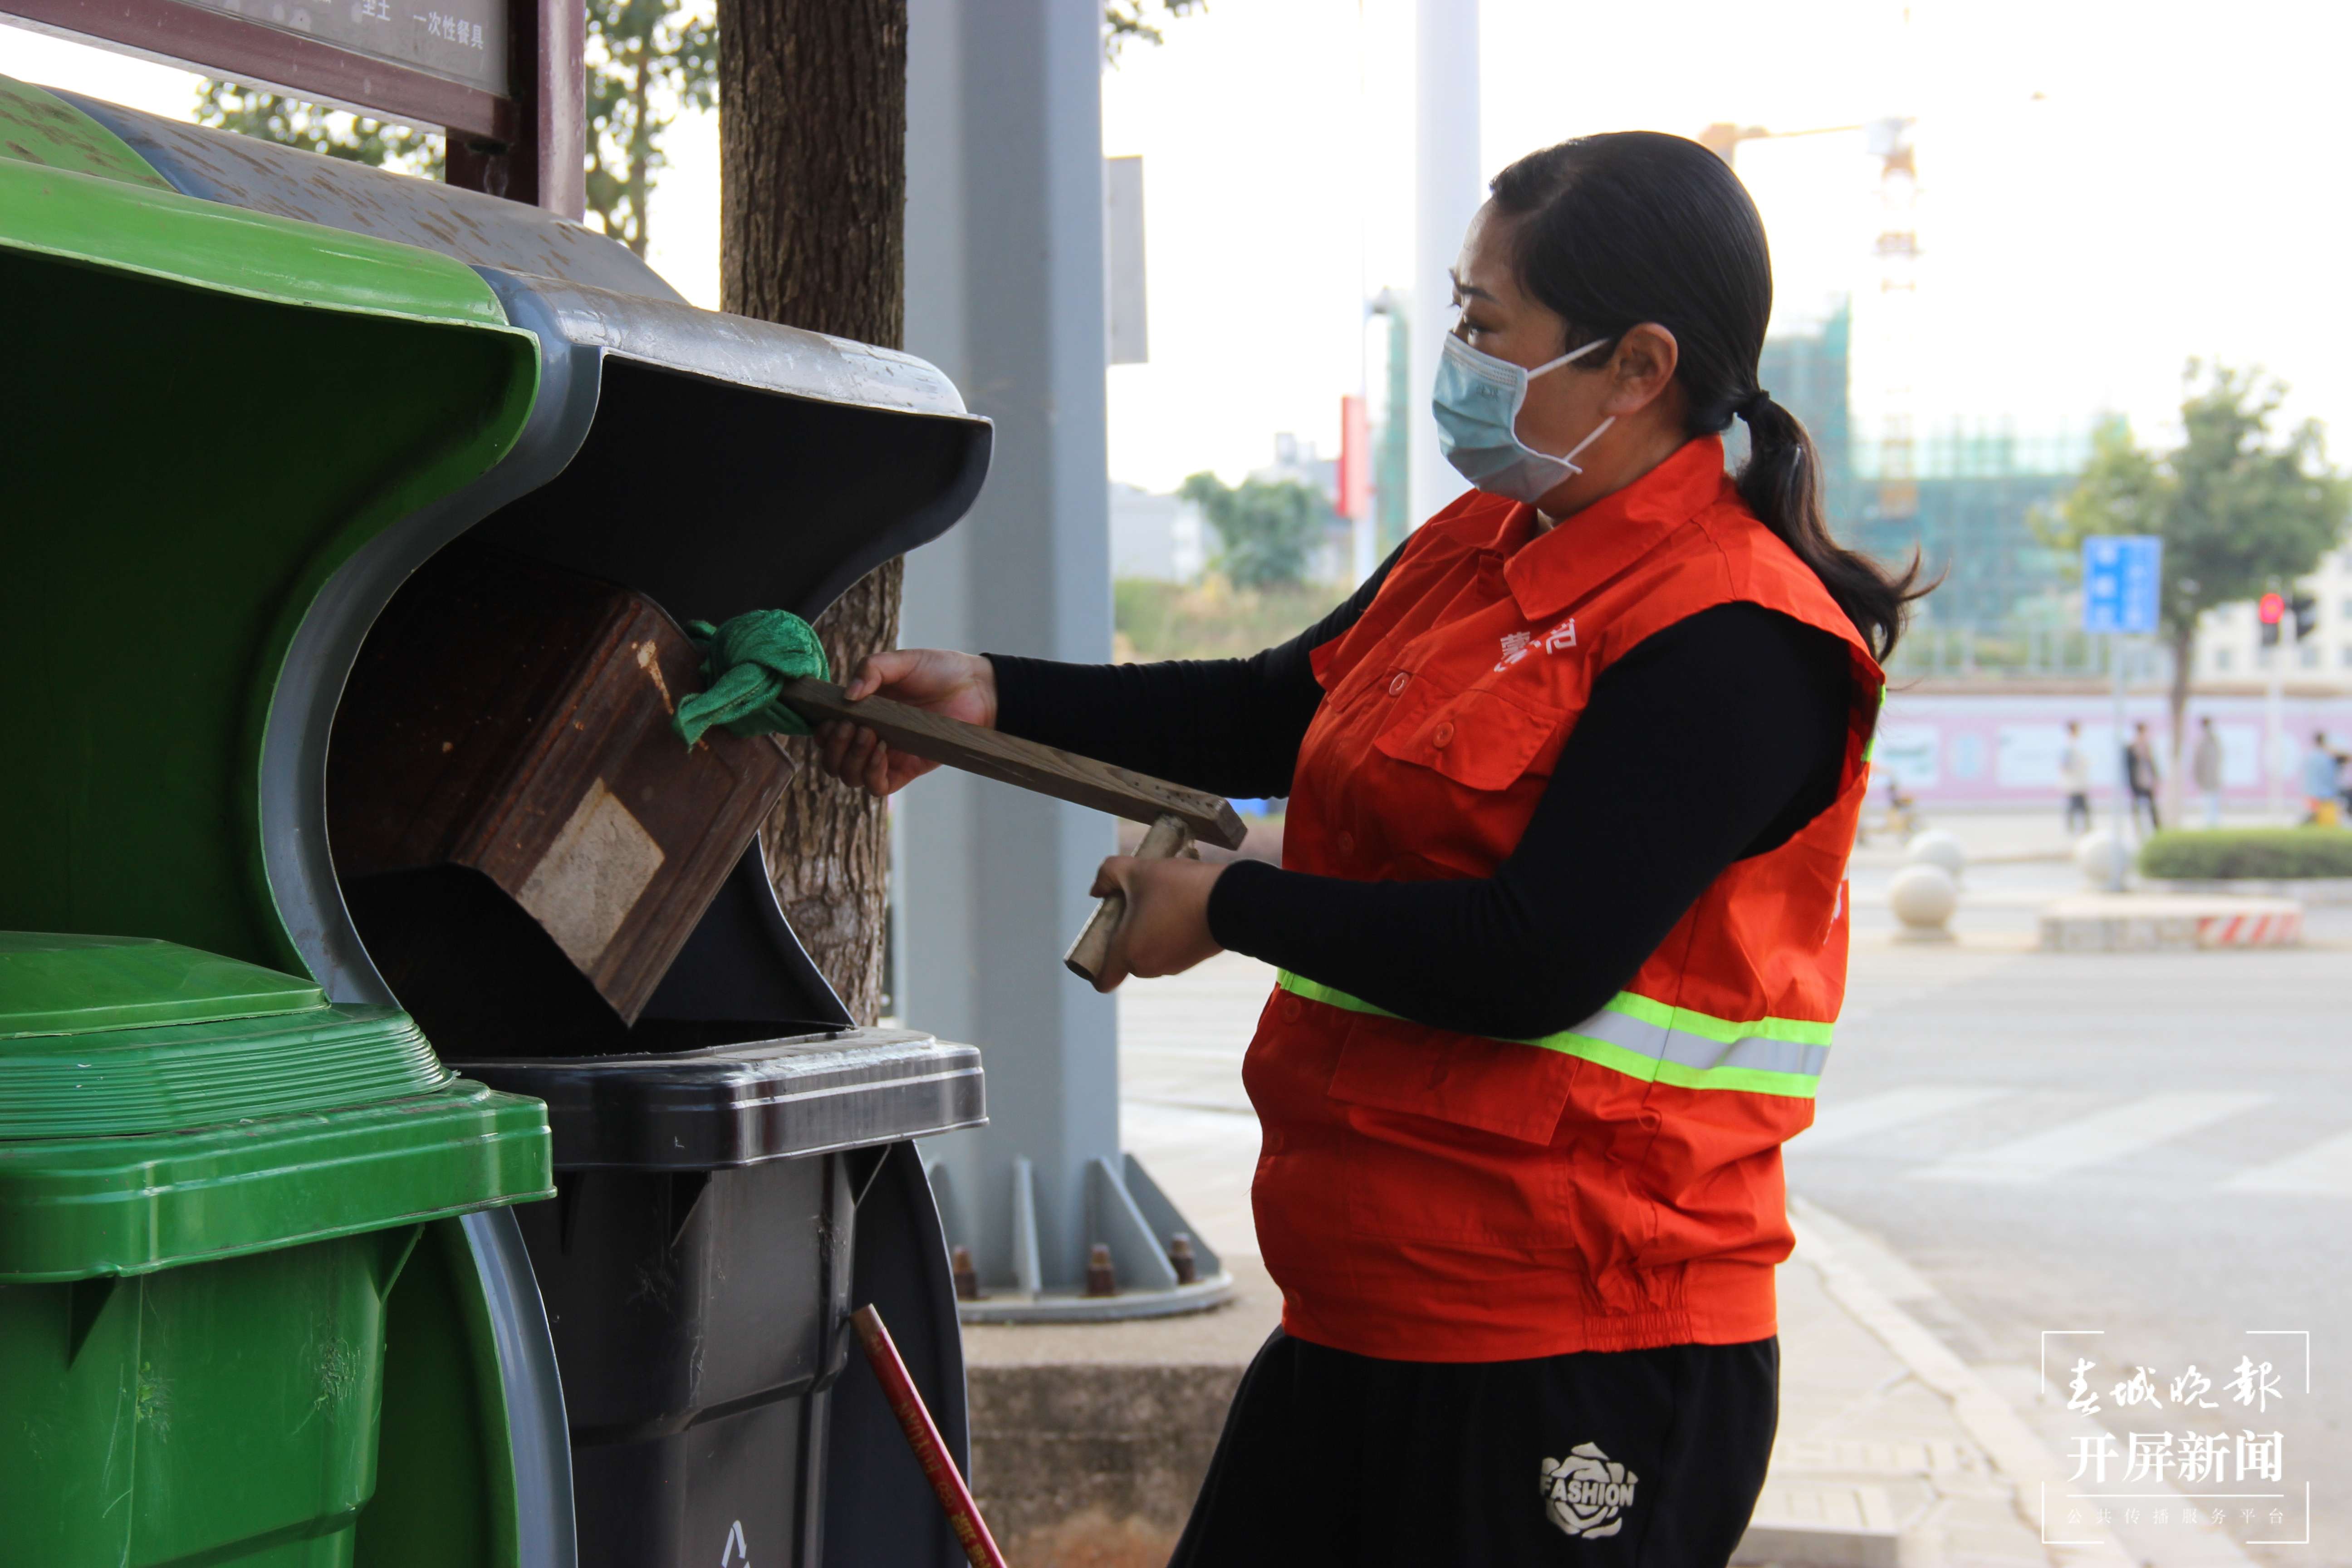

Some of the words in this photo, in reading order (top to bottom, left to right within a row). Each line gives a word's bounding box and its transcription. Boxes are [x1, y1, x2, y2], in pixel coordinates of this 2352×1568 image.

[413, 11, 484, 49] 一次性餐具
[896, 1400, 942, 1473] FUYUAN
[1540, 1475, 1635, 1507] FASHION
